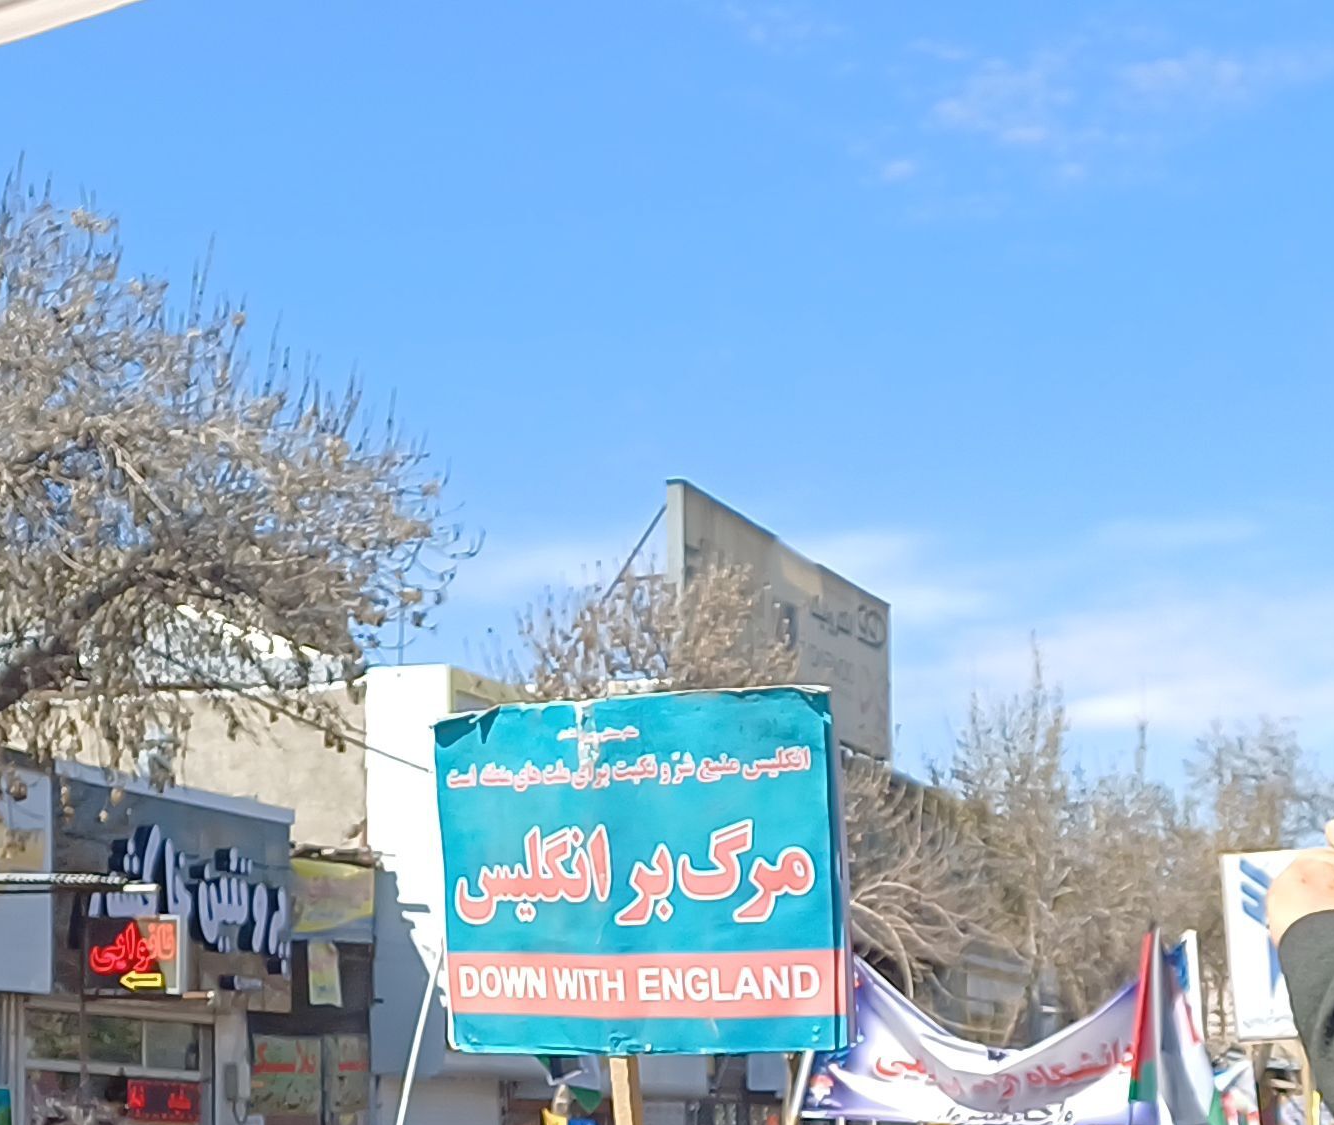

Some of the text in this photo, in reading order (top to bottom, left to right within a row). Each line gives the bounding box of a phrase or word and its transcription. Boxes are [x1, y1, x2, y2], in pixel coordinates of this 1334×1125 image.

[447, 763, 478, 788] است
[613, 754, 658, 785] نکبت
[659, 761, 671, 785] و
[697, 753, 741, 783] منبع
[742, 745, 812, 780] انگلیس
[455, 824, 611, 925] انگلیس
[615, 843, 674, 926] بر
[678, 818, 816, 924] مرگ
[458, 964, 819, 1001] DOWN WITH ENGLAND
